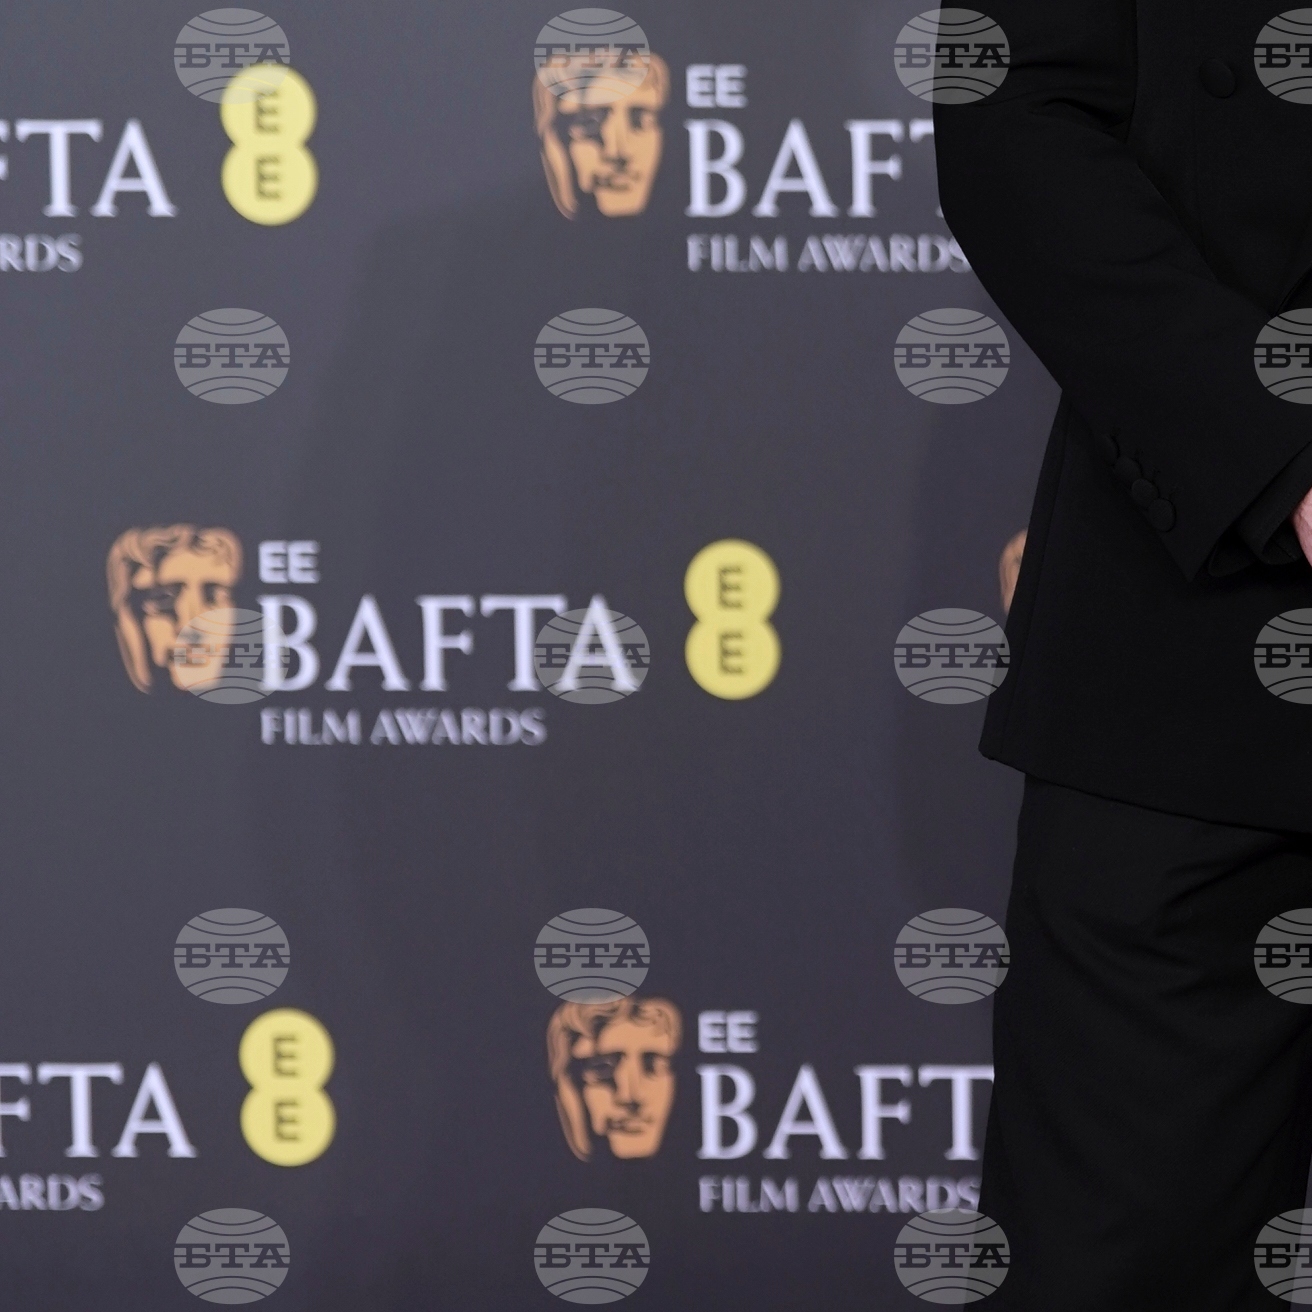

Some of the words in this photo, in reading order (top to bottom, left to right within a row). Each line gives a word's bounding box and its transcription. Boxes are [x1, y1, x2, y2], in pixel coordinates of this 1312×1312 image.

[685, 64, 747, 108] EE
[0, 118, 180, 218] TA
[685, 119, 943, 218] BAF
[686, 234, 789, 273] FILM
[258, 540, 319, 584] EE
[257, 593, 642, 693] BAFTA
[259, 707, 361, 745] FILM
[369, 706, 547, 746] AWARDS
[698, 1010, 758, 1054] EE
[698, 1175, 798, 1213] FILM
[808, 1175, 981, 1214] AWARDS
